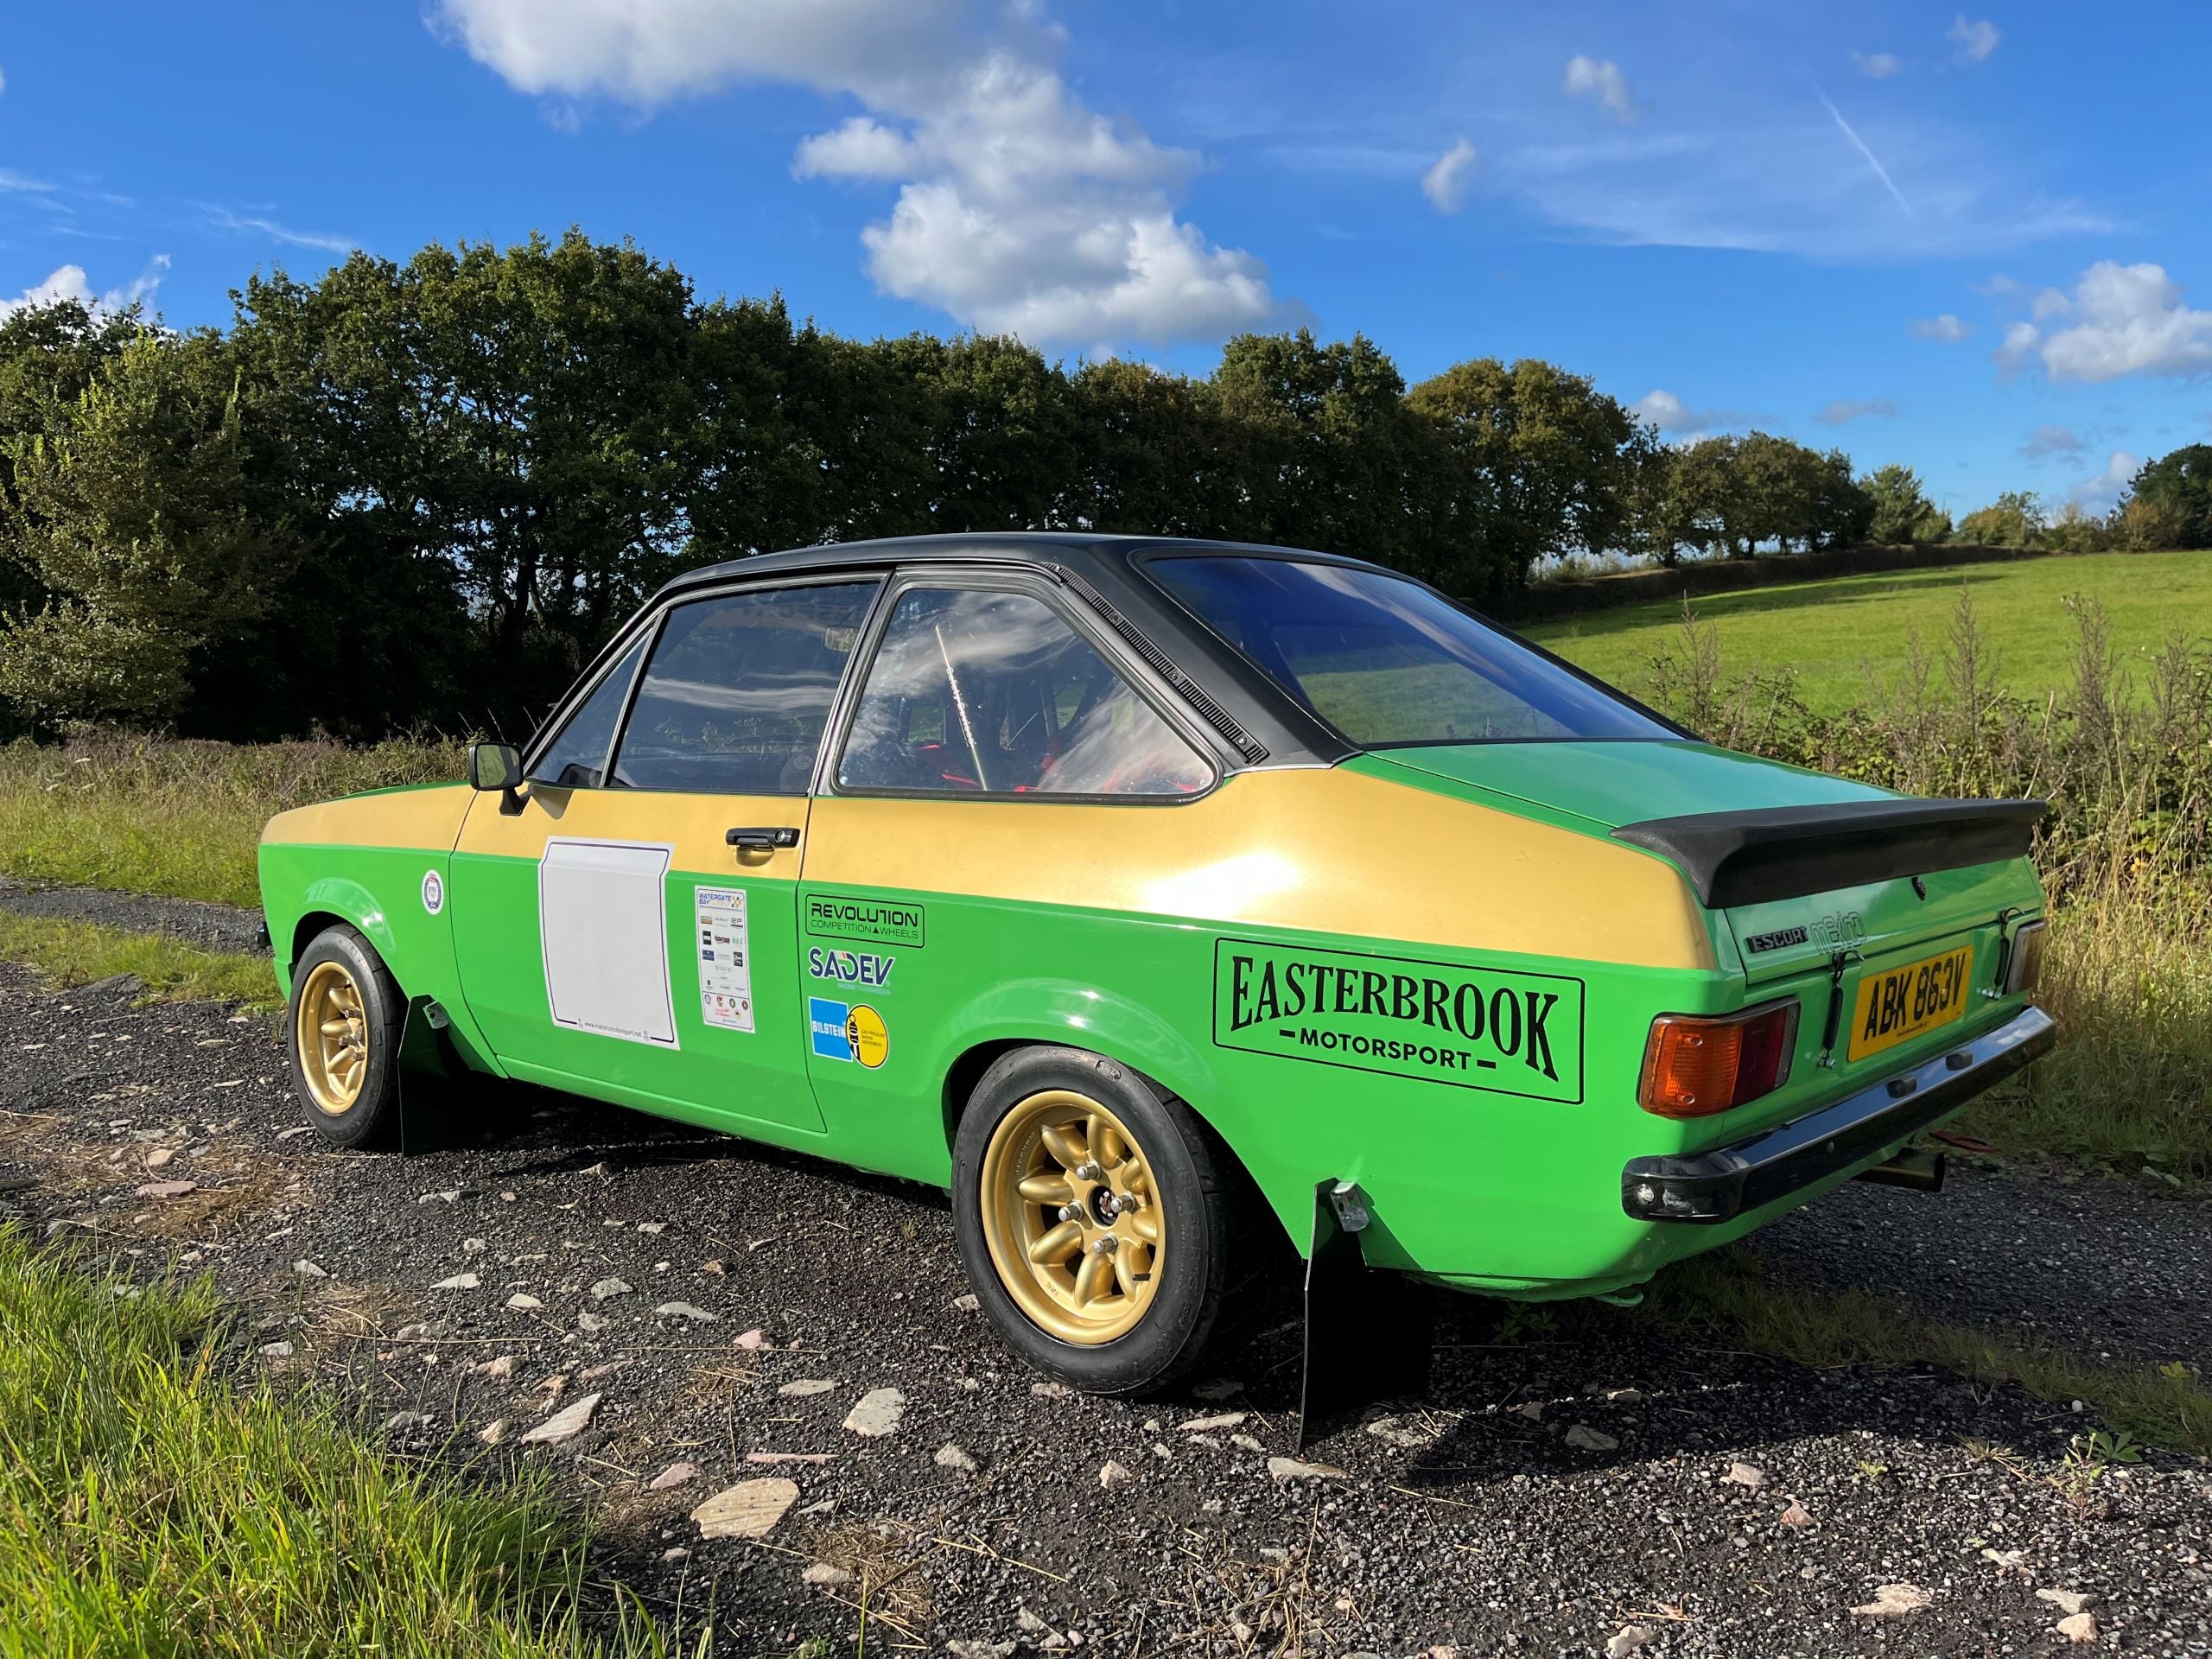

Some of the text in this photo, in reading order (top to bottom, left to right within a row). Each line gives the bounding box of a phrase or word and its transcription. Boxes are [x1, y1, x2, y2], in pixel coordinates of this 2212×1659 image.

[698, 893, 732, 901] WATERGATE
[811, 903, 918, 927] REVOLUTION
[810, 919, 918, 939] COMPETITION WHEELS
[1751, 927, 1807, 951] ESCORT
[809, 946, 895, 987] SADEV
[1864, 952, 1966, 1041] ABK 863V
[812, 1020, 847, 1038] BILSTEIN
[1230, 956, 1559, 1083] EASTERBROOK
[1300, 1028, 1471, 1070] MOTORSPORT
